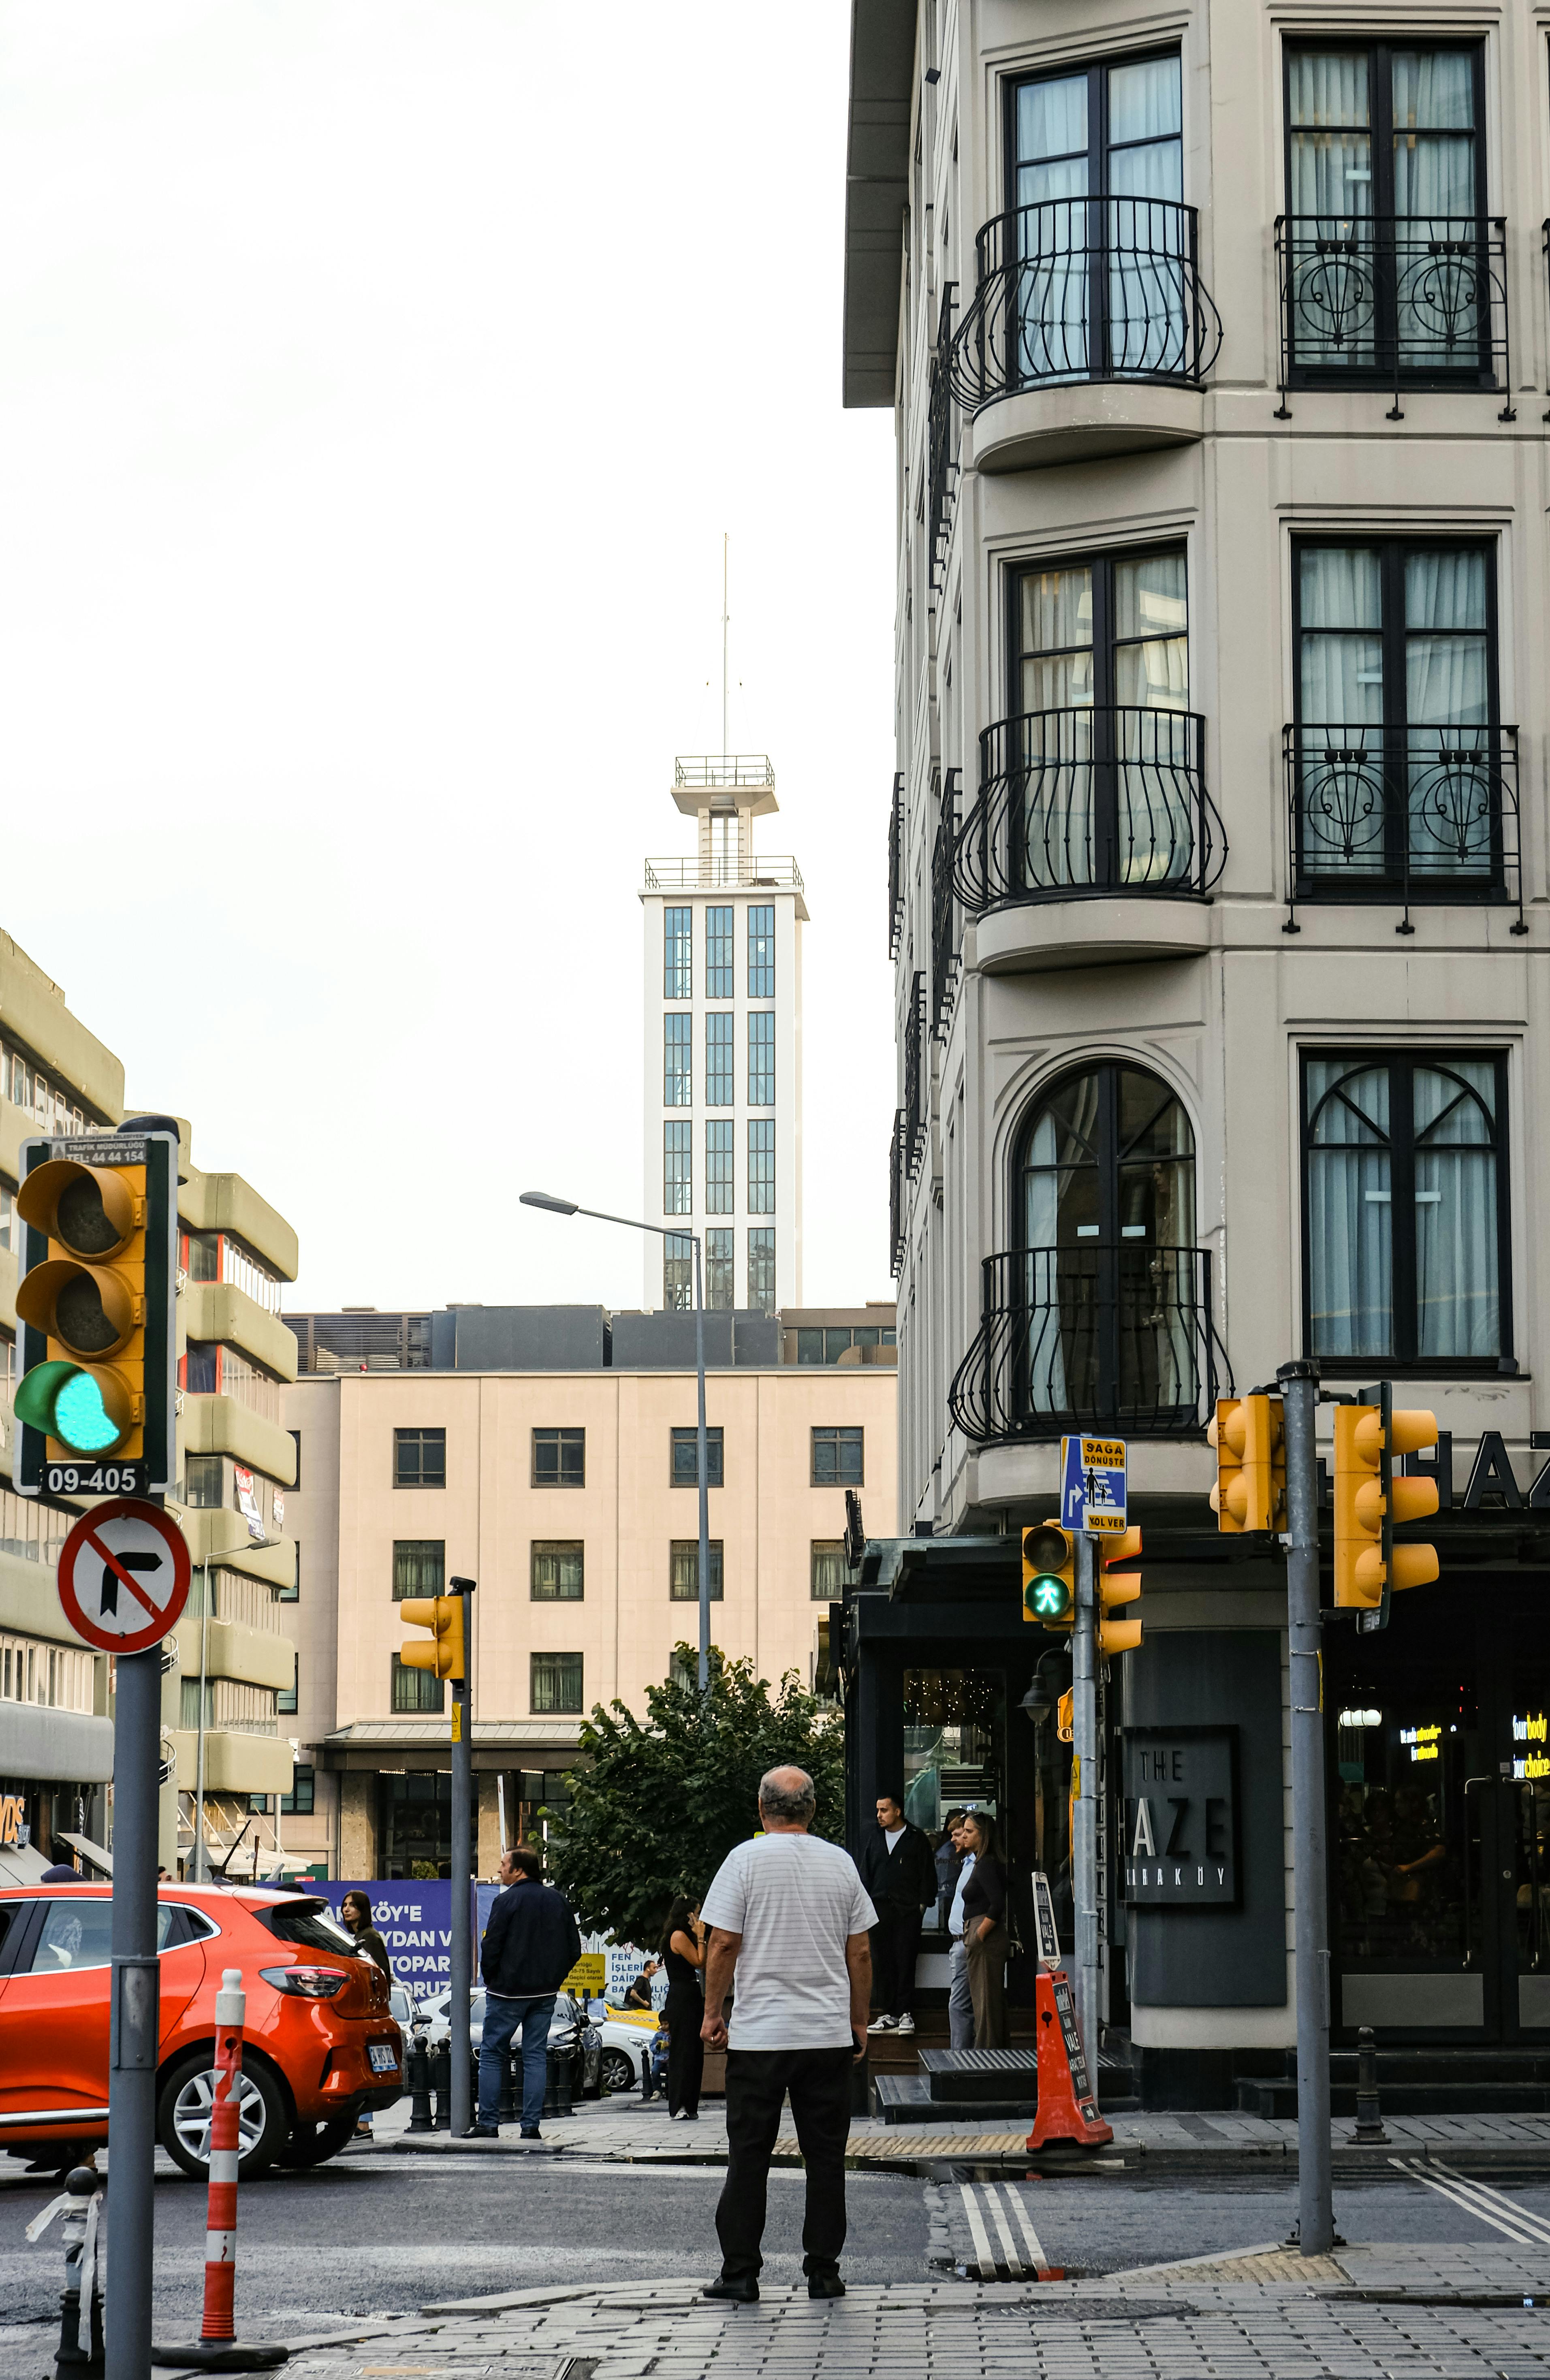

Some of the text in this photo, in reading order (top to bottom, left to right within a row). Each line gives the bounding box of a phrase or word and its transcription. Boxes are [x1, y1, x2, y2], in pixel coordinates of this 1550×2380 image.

[96, 1141, 145, 1150] MÜDÜRLÜĞÜ
[92, 1152, 105, 1162] 44
[108, 1151, 122, 1162] 44
[124, 1151, 144, 1161] 154
[1086, 1442, 1123, 1455] SAĞA
[1085, 1456, 1124, 1466] DÖNÜŞTE
[49, 1468, 136, 1492] 09-405
[1089, 1517, 1124, 1528] YOL VER
[1527, 1712, 1548, 1743] body
[1140, 1750, 1183, 1782] THE
[1117, 1797, 1225, 1857] HAZE
[439, 1930, 452, 1947] V
[388, 1956, 450, 1972] TOPAR
[612, 1962, 643, 1972] İŞLERİ
[1064, 2031, 1080, 2052] VALE
